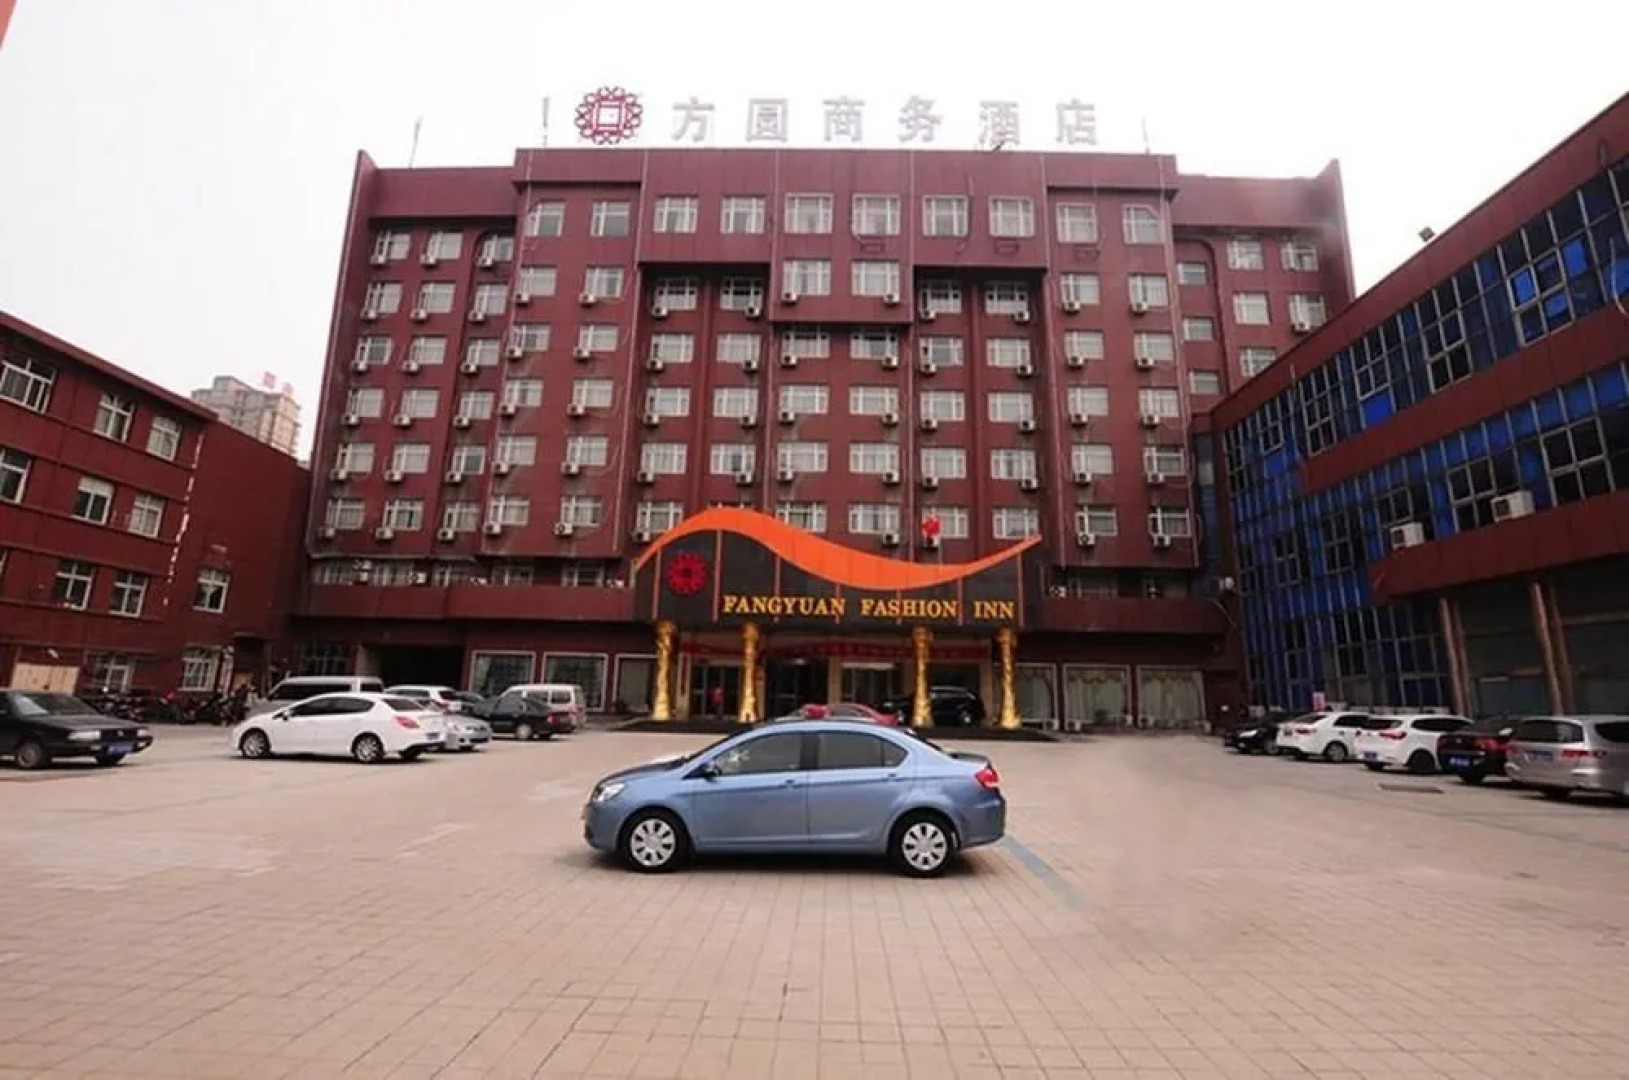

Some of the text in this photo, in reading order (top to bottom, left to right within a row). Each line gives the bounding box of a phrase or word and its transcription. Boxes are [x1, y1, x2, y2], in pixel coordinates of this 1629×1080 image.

[671, 95, 1099, 145] 方圆商务酒店
[723, 595, 1016, 619] FANGYUAN FASHION INN
